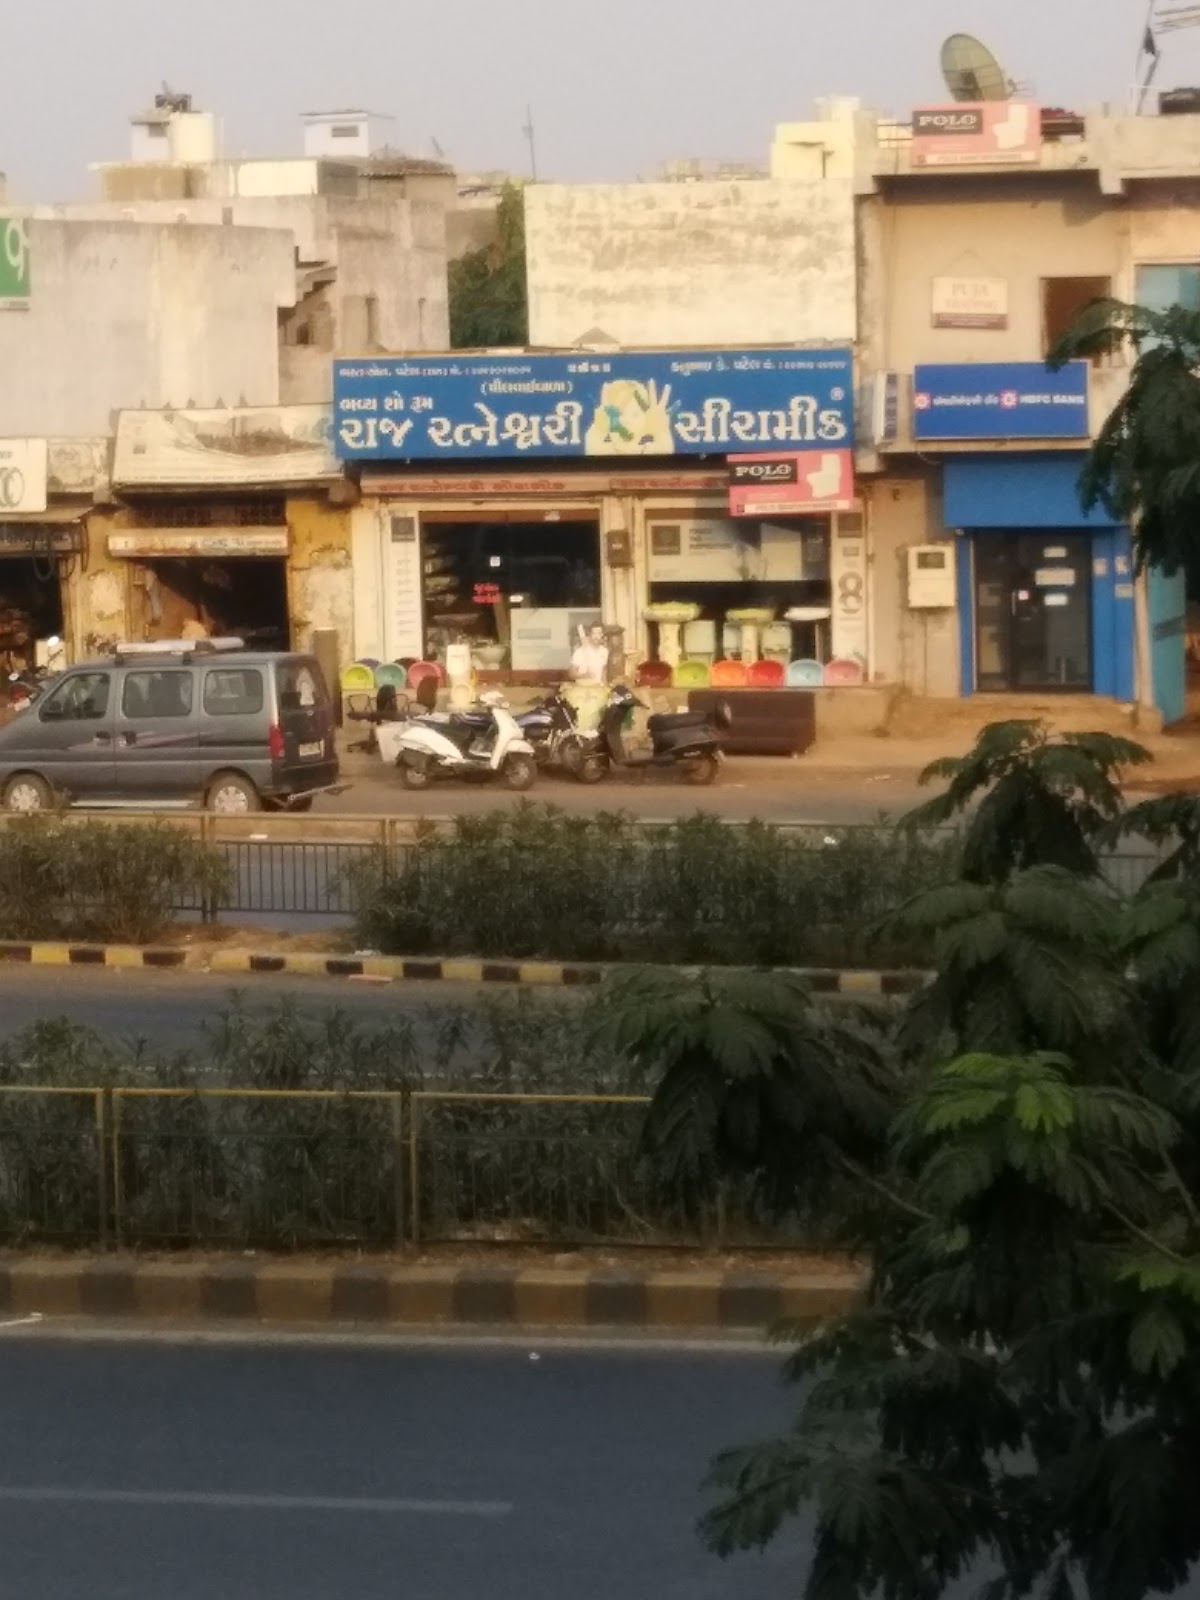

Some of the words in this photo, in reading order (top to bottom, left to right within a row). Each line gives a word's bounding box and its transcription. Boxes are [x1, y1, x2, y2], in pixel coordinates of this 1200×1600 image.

[919, 114, 977, 126] POLO
[339, 417, 413, 449] રાજ
[427, 400, 583, 450] રત્નેશ્વરી
[674, 395, 848, 444] સીરામીક
[735, 463, 792, 477] POLO
